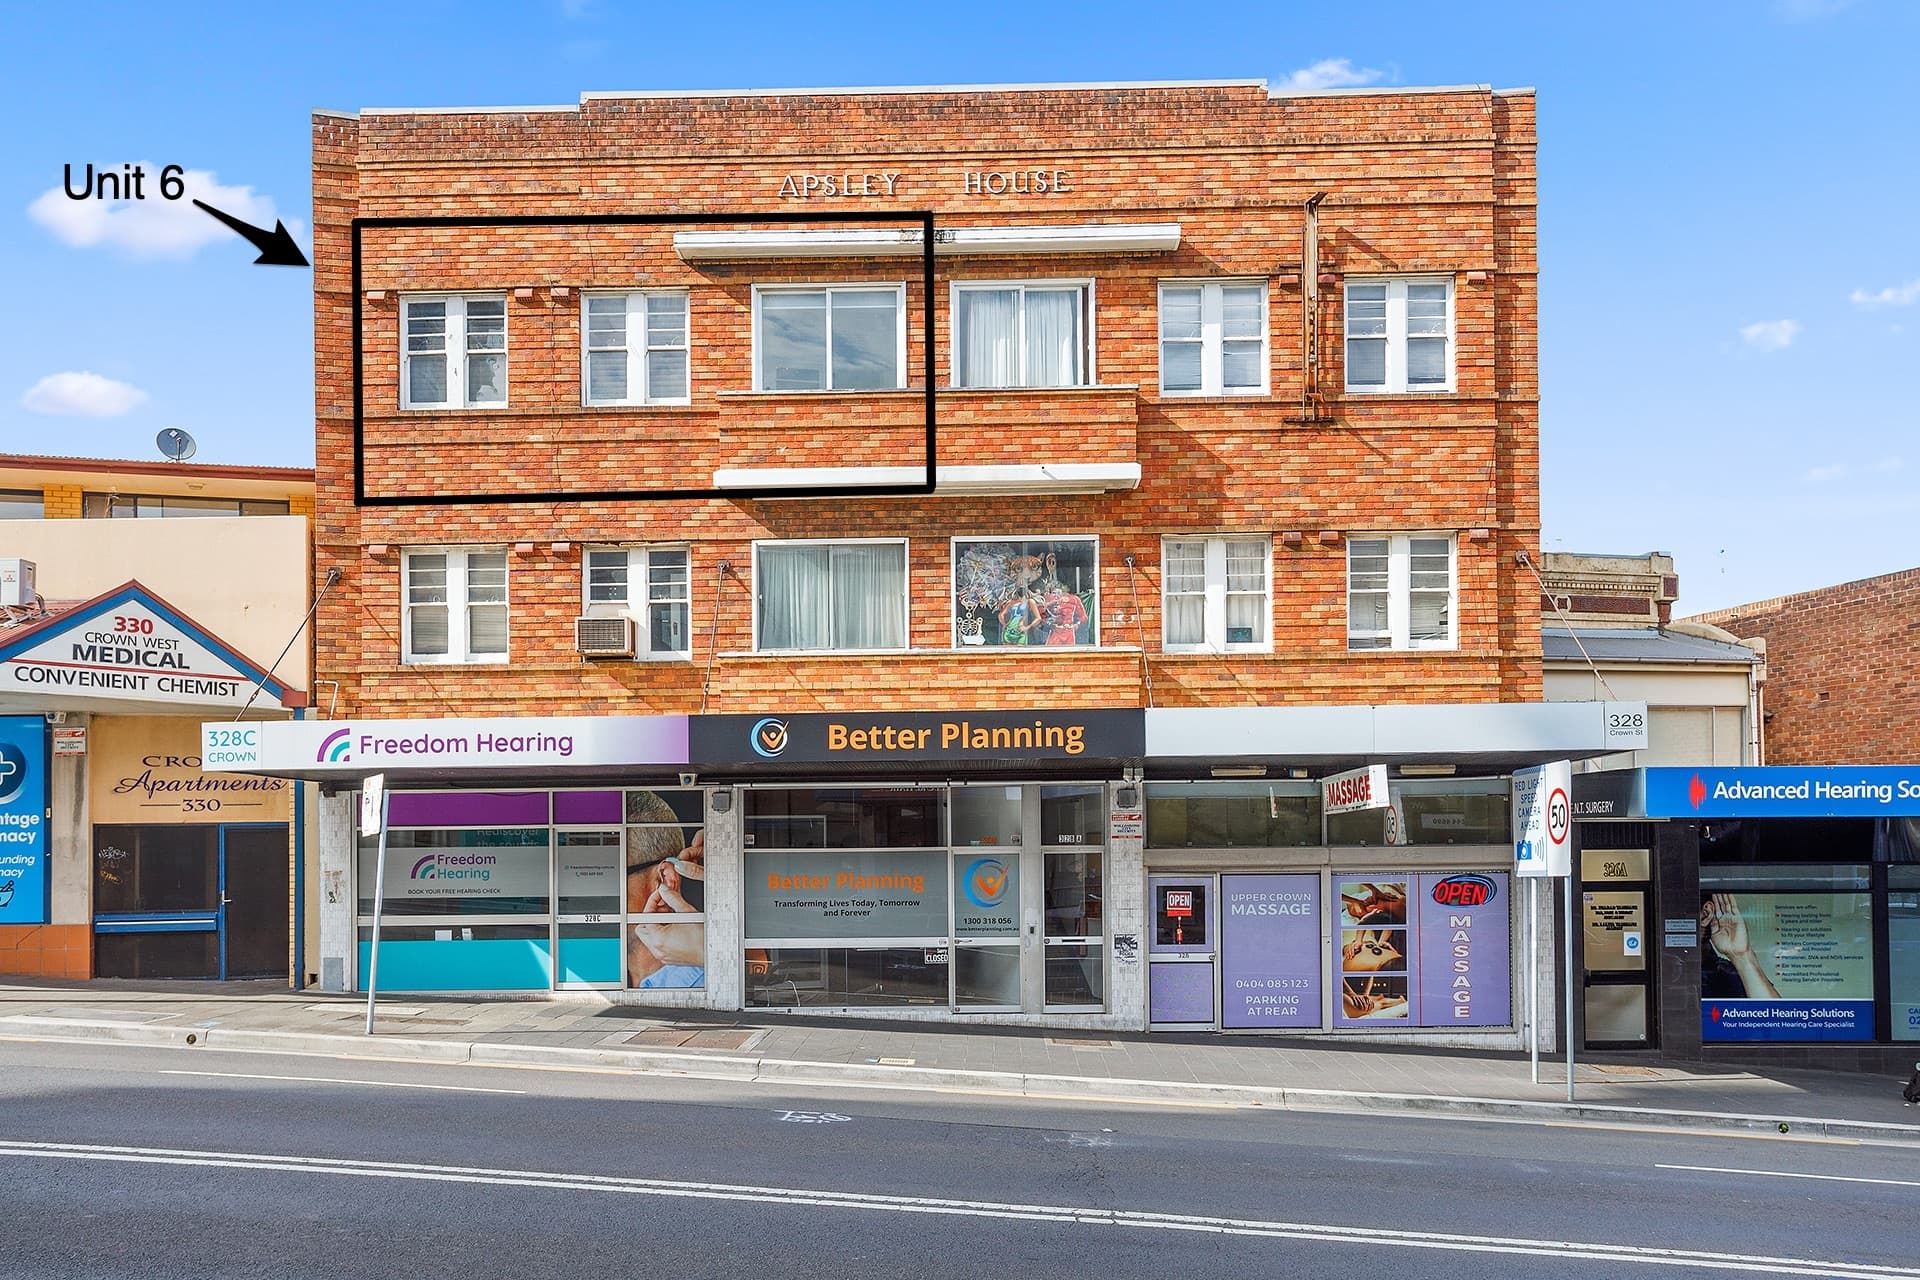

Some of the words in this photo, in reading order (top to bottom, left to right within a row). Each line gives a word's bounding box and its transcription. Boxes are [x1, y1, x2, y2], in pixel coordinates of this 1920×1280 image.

[778, 172, 900, 197] APSLEY
[964, 170, 1073, 194] HOUSE
[113, 616, 154, 635] 330
[85, 631, 137, 647] CROWN
[142, 637, 180, 651] WEST
[72, 644, 190, 670] MEDICAL
[14, 666, 149, 690] CONVENIENT
[157, 677, 240, 697] CHEMIST
[1609, 713, 1643, 727] 328
[208, 730, 257, 747] 328C
[360, 733, 468, 755] Freedom
[477, 732, 574, 757] Hearing
[827, 723, 931, 751] Better
[941, 721, 1085, 755] Planning
[208, 752, 257, 763] CROWN
[113, 769, 288, 799] Apartments
[1327, 775, 1372, 807] MASSAGE
[1514, 780, 1526, 791] RED
[1713, 780, 1809, 799] Advanced
[1815, 780, 1892, 803] Hearing
[182, 799, 221, 812] 330
[1586, 800, 1614, 814] SURGERY
[1551, 804, 1566, 829] 50
[437, 854, 497, 865] Freedom
[437, 867, 490, 881] Hearing
[1603, 862, 1628, 877] 326A
[768, 872, 832, 891] Better
[836, 871, 926, 894] Planning
[1231, 893, 1266, 902] UPPER
[1269, 893, 1312, 902] CROWN
[1434, 880, 1489, 906] OPEN
[774, 900, 828, 909] Transforming
[829, 900, 850, 908] Lives
[851, 900, 877, 908] Today,
[879, 899, 921, 907] Tomorrow
[1169, 894, 1190, 907] OPEN
[823, 909, 839, 917] and
[840, 909, 872, 917] Forever
[1231, 903, 1311, 916] MASSAGE
[963, 917, 981, 925] 1300
[982, 917, 997, 925] 318
[997, 917, 1012, 925] 056
[1450, 914, 1473, 1018] MASSAGE
[1235, 979, 1264, 988] 0404
[1266, 979, 1288, 988] 085
[1291, 979, 1309, 988] 123
[1245, 995, 1300, 1005] PARKING
[1247, 1007, 1262, 1016] AT
[1264, 1006, 1298, 1016] REAR
[1722, 1008, 1769, 1018] Advanced
[1771, 1008, 1809, 1020] Hearing
[1810, 1008, 1855, 1018] Solutions
[1738, 1021, 1781, 1029] Independent
[1781, 1021, 1807, 1029] Hearing
[1824, 1021, 1855, 1029] Specialist
